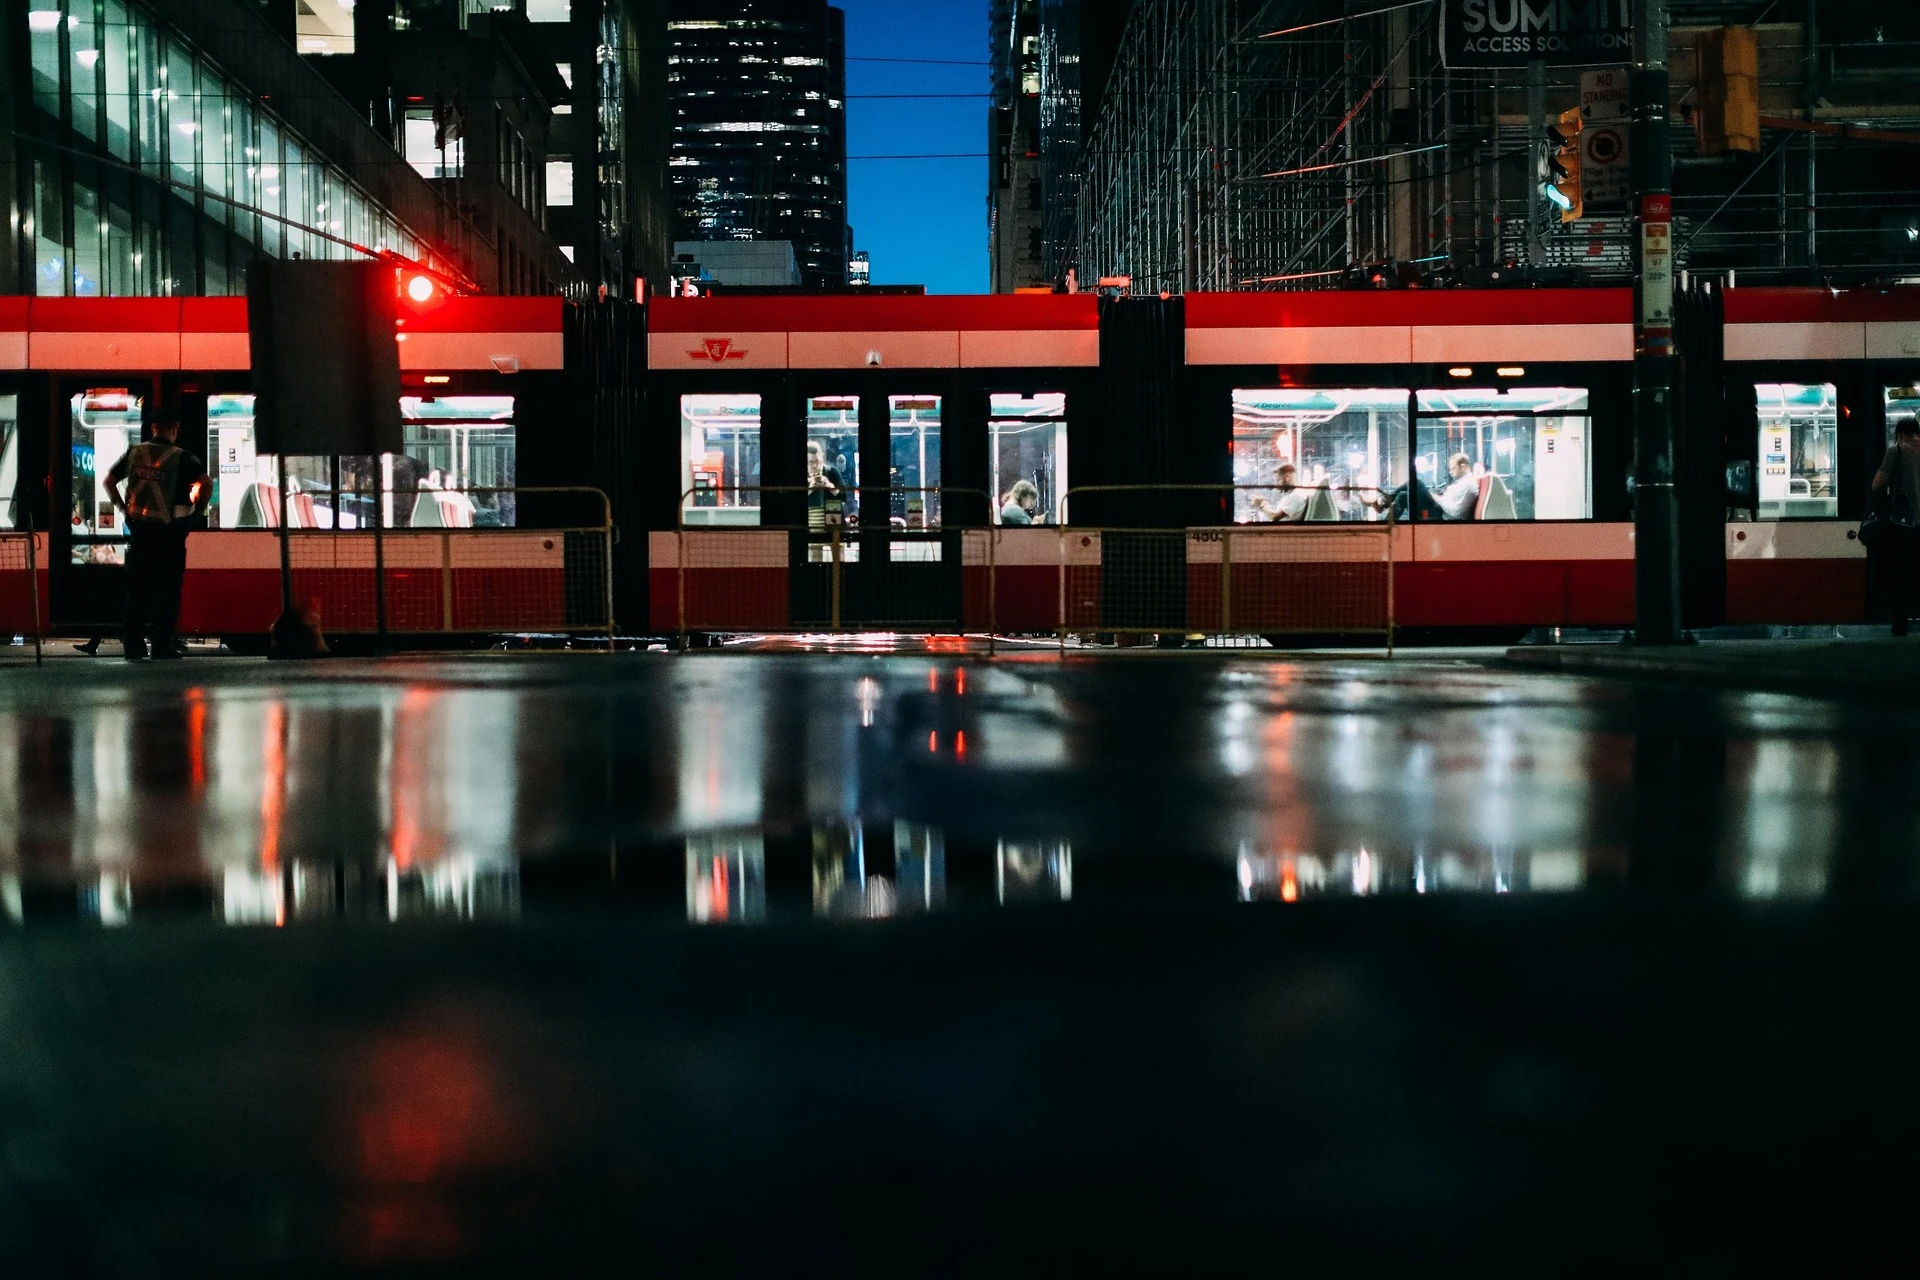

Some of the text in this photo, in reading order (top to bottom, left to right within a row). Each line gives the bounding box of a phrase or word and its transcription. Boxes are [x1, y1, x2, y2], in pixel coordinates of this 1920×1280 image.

[1463, 36, 1531, 53] ACCESS
[1596, 73, 1613, 86] NO
[1583, 88, 1628, 104] STANDING
